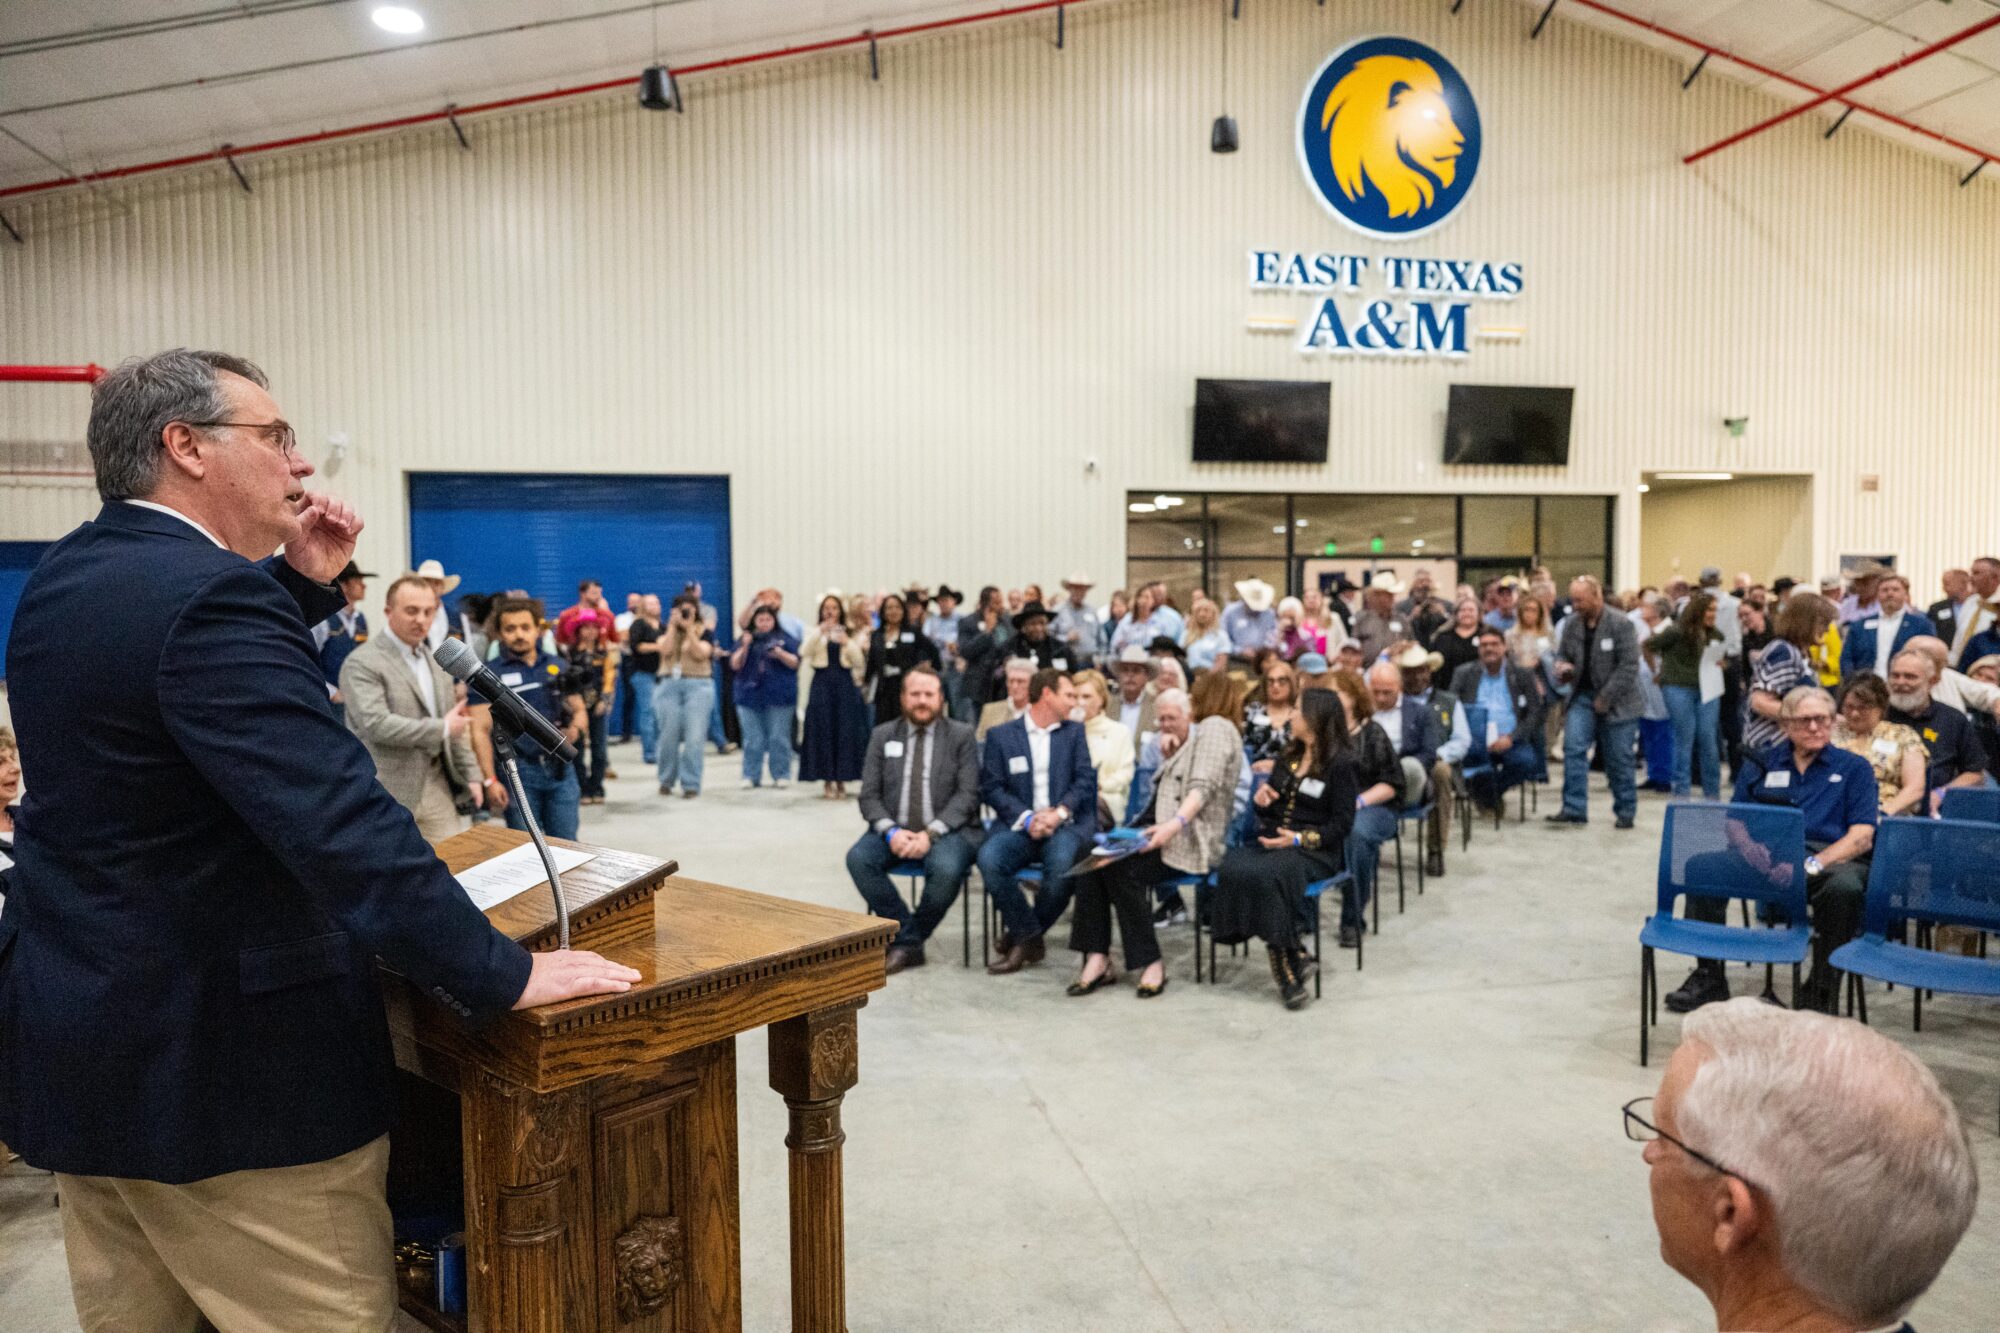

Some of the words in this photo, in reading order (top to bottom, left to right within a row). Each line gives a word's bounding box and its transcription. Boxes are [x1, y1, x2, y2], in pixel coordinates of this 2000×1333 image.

[1254, 251, 1368, 286] EAST
[1383, 256, 1523, 293] TEXAS
[1305, 297, 1472, 353] A&M
